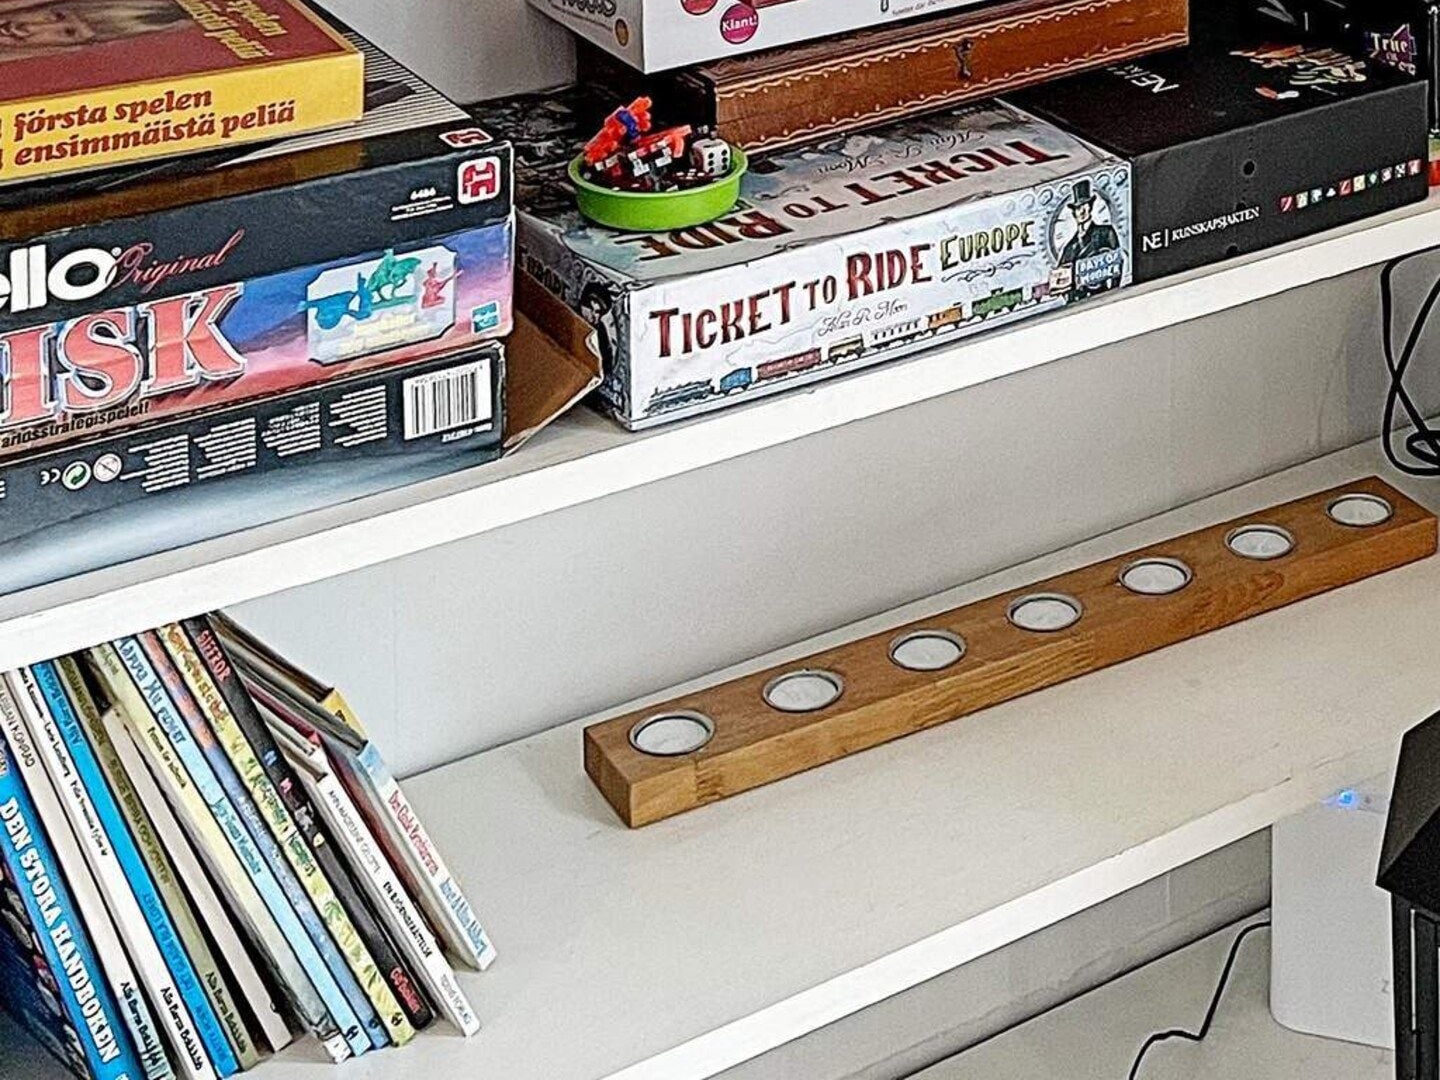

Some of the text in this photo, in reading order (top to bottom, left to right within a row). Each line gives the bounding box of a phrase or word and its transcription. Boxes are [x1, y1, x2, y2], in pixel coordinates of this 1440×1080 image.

[14, 89, 213, 142] första spelen
[14, 99, 296, 167] ensimmäistä peliä
[845, 140, 1071, 207] TICKET
[782, 195, 850, 219] TO
[105, 228, 246, 294] Original
[1142, 230, 1163, 253] NE
[649, 220, 1036, 358] TICKET TO RIDE EUROPE
[1, 796, 32, 852] DEN
[20, 846, 63, 930] STORA
[49, 919, 121, 1064] HANDBOKEN
